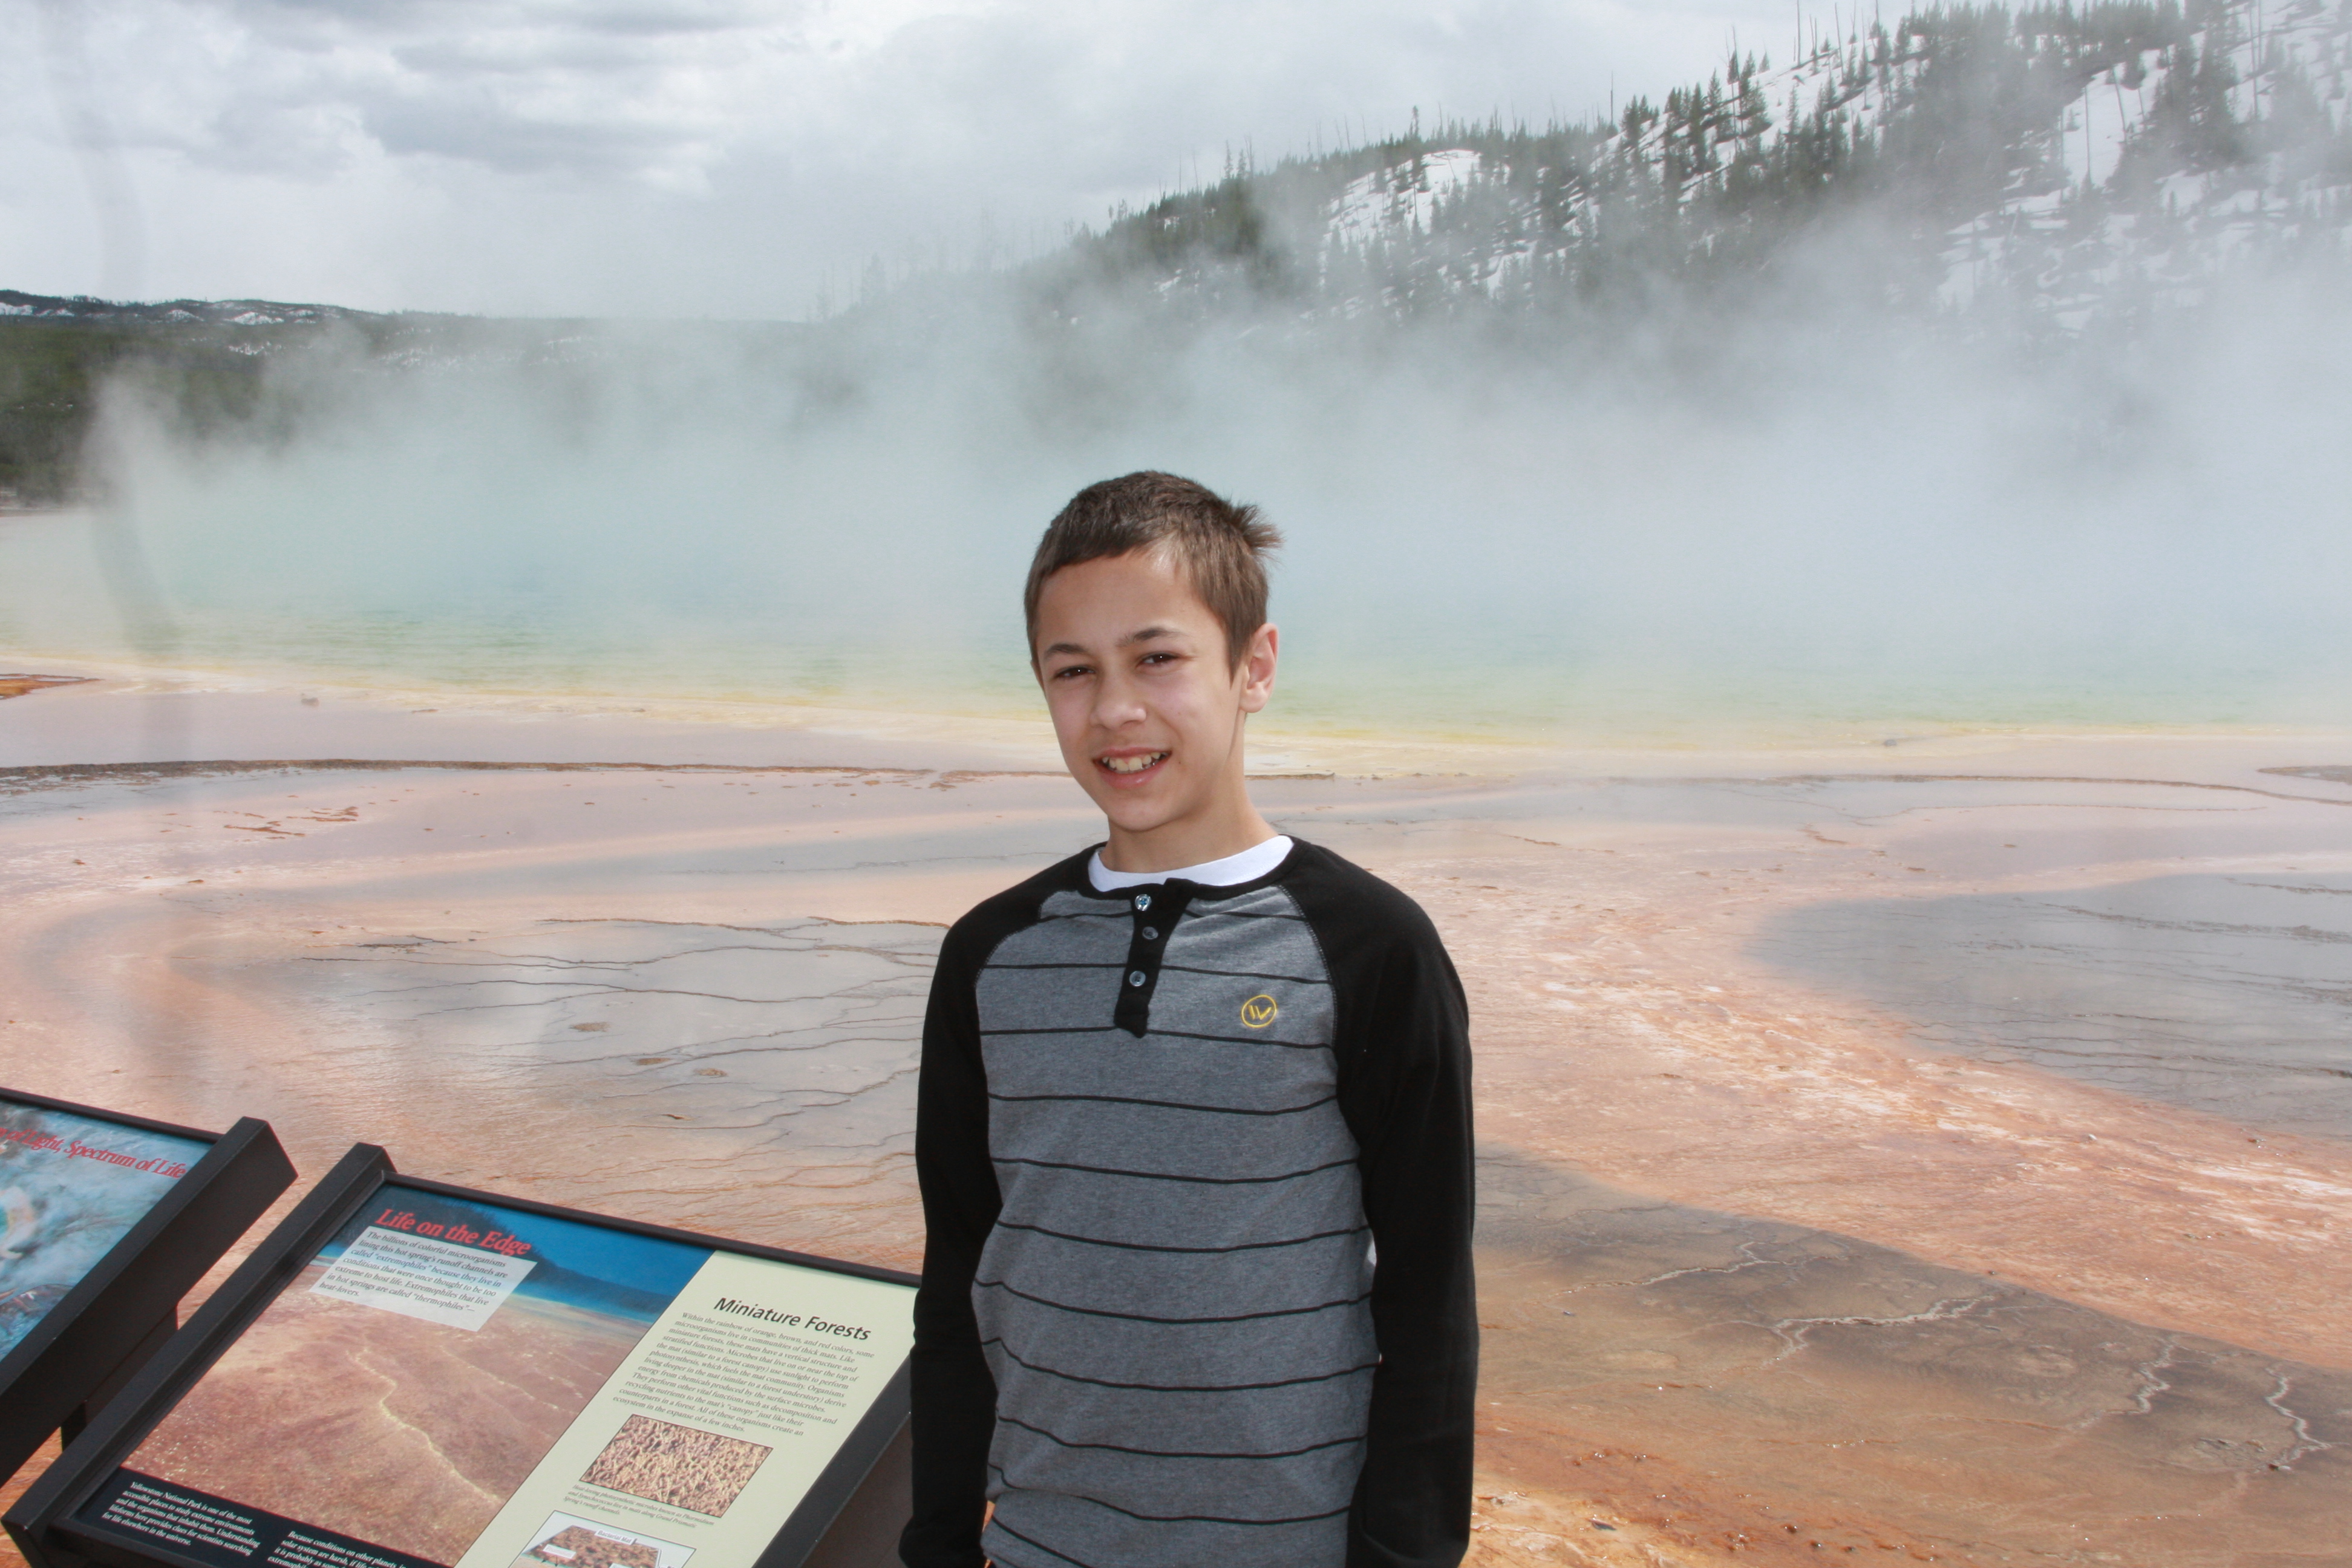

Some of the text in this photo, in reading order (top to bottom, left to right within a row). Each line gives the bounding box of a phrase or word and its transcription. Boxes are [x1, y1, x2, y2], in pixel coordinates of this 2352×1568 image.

[6, 1129, 32, 1142] of
[21, 1130, 64, 1154] Light,
[64, 1140, 137, 1168] Spectrum
[135, 1158, 161, 1171] of
[151, 1159, 186, 1178] Life
[375, 1209, 532, 1256] Life on the Edge
[358, 1240, 380, 1250] lining
[394, 1247, 408, 1256] hot
[408, 1253, 436, 1263] spring’s
[436, 1259, 463, 1267] runoff
[461, 1263, 494, 1275] channels
[367, 1231, 381, 1240] The
[381, 1235, 408, 1246] billions
[417, 1244, 448, 1254] colorful
[447, 1251, 506, 1267] microorganisms
[335, 1267, 364, 1276] extreme
[373, 1273, 390, 1282] host
[389, 1277, 402, 1285] life.
[404, 1281, 457, 1298] Extremophiles
[459, 1293, 475, 1302] that
[474, 1296, 489, 1305] live
[336, 1275, 349, 1283] hot
[350, 1280, 375, 1290] springs
[388, 1289, 413, 1298] called
[343, 1258, 379, 1270] conditions
[433, 1278, 463, 1289] thought
[431, 1266, 460, 1278] because
[460, 1273, 476, 1283] they
[478, 1276, 492, 1285] live
[682, 1312, 704, 1322] Within
[716, 1321, 742, 1330] rainbow
[713, 1298, 872, 1341] Miniature Forests
[662, 1336, 693, 1345] stratified
[726, 1349, 757, 1360] Microbes
[668, 1328, 701, 1339] miniature
[762, 1347, 778, 1356] have
[785, 1354, 811, 1362] vertical
[810, 1359, 842, 1369] structure
[675, 1321, 727, 1336] microorganisms
[748, 1337, 791, 1350] communities
[613, 1397, 646, 1408] ecosystem
[666, 1410, 694, 1419] expanse
[130, 1481, 163, 1497] Yellowstone
[163, 1492, 189, 1504] National
[187, 1500, 202, 1509] Park
[121, 1519, 149, 1532] elsewhere
[122, 1491, 151, 1502] accessible
[149, 1499, 168, 1508] places
[175, 1508, 191, 1516] study
[191, 1513, 215, 1523] extreme
[214, 1520, 255, 1535] environments
[137, 1505, 166, 1517] organisms
[178, 1518, 200, 1527] inhabit
[217, 1529, 261, 1549] Understanding
[109, 1504, 134, 1517] lifeforms
[134, 1512, 148, 1521] here
[146, 1518, 172, 1529] provides
[172, 1525, 187, 1534] clues
[197, 1534, 223, 1546] scientists
[223, 1543, 253, 1557] searching
[288, 1530, 313, 1543] Because
[355, 1553, 374, 1561] other
[284, 1552, 313, 1565] probably
[297, 1546, 318, 1555] system
